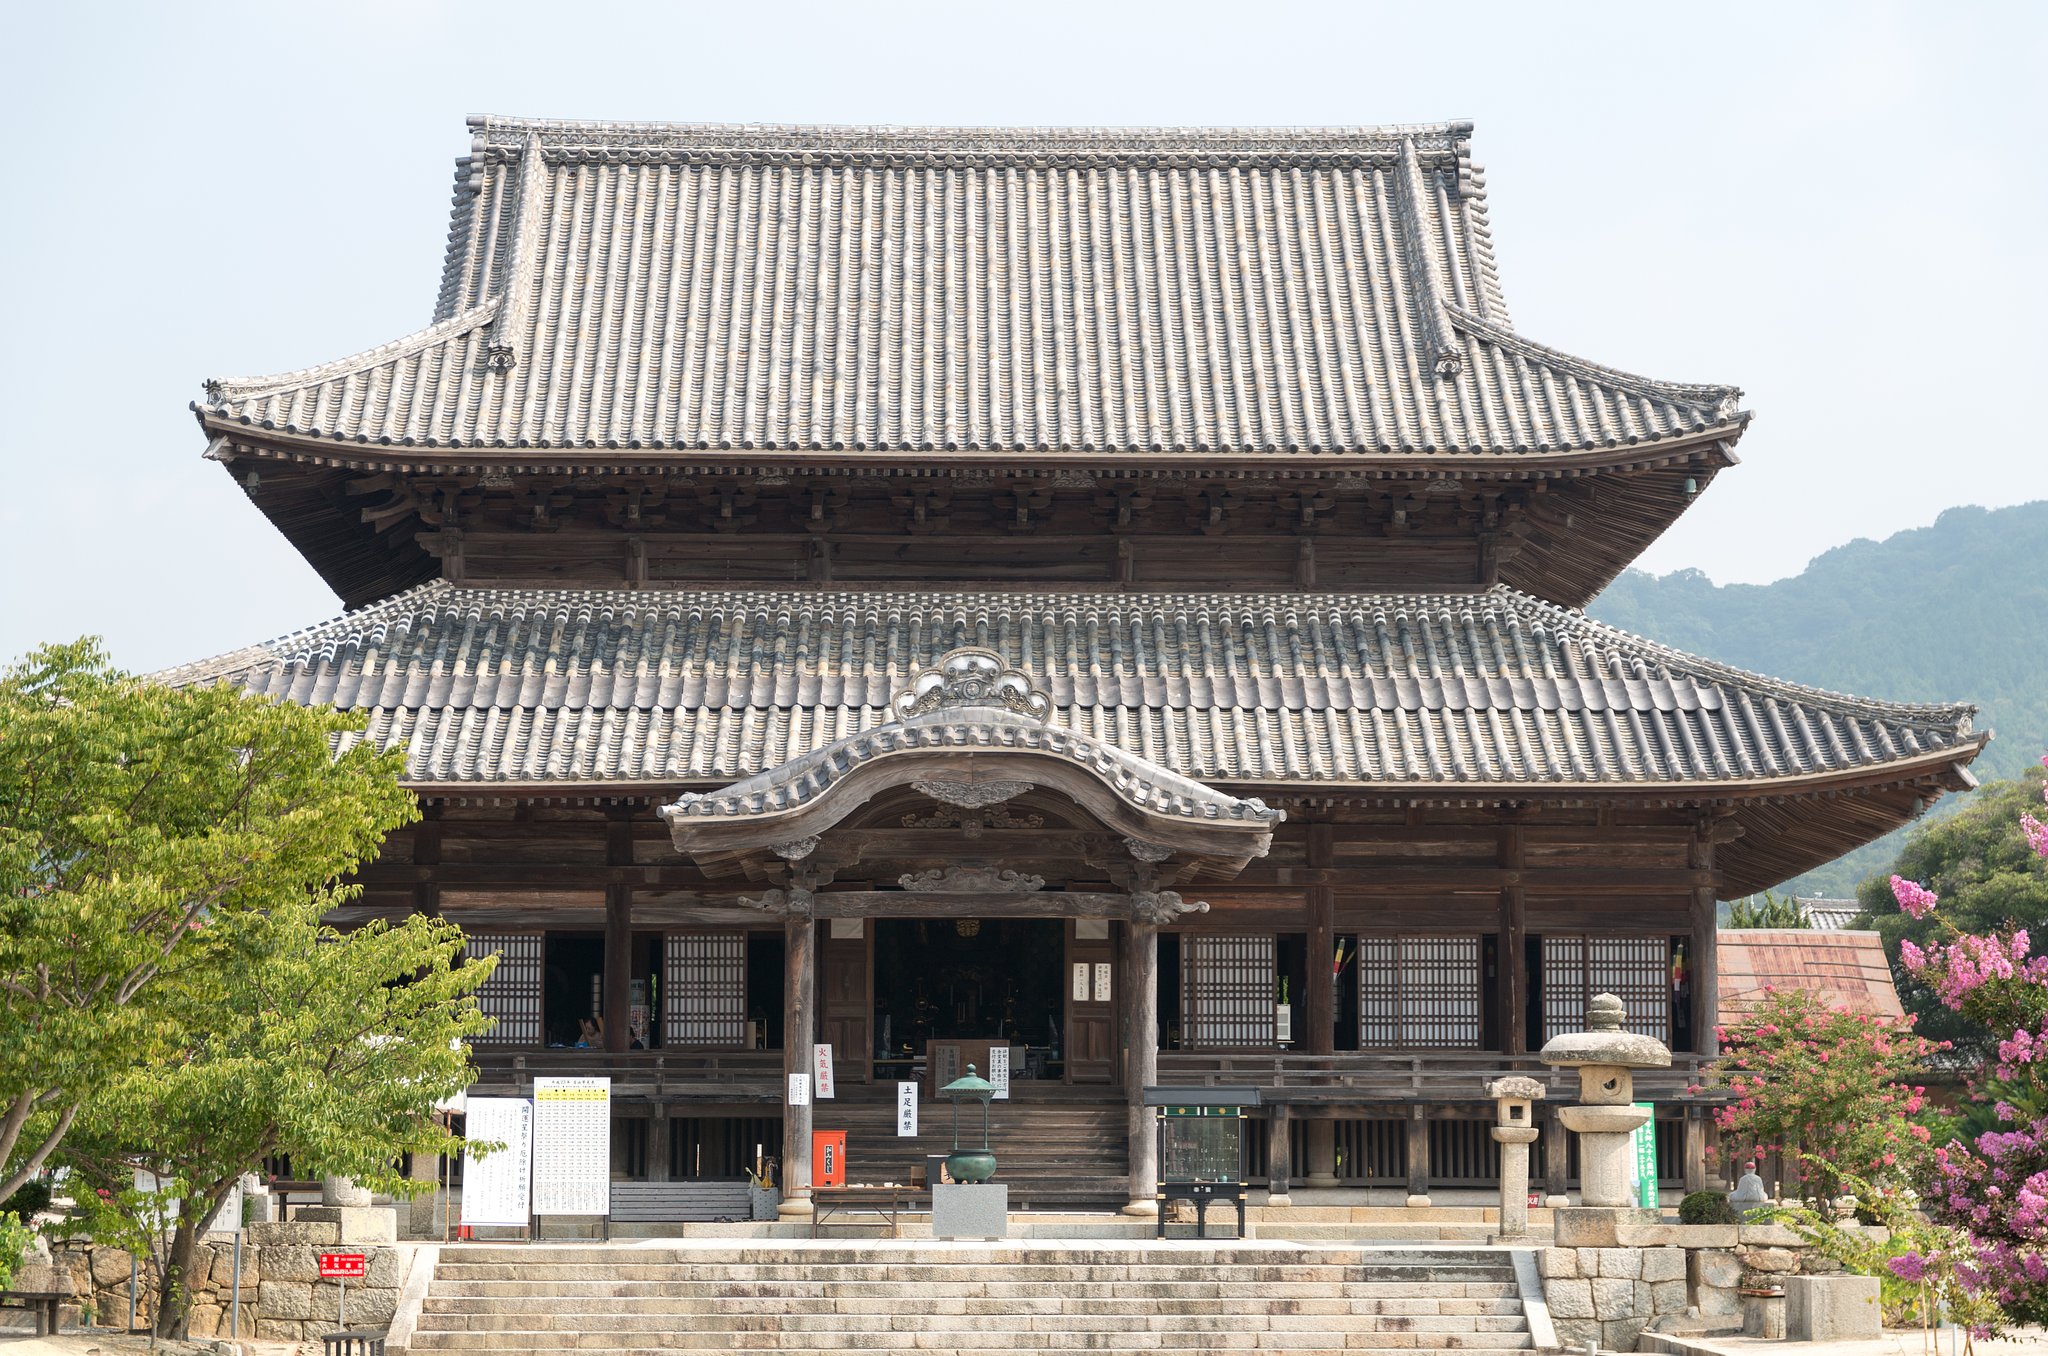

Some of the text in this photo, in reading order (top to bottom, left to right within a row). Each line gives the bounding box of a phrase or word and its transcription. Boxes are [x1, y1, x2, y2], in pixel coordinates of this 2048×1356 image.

[818, 1047, 829, 1093] 火気厳禁
[903, 1085, 913, 1131] 土足厳禁
